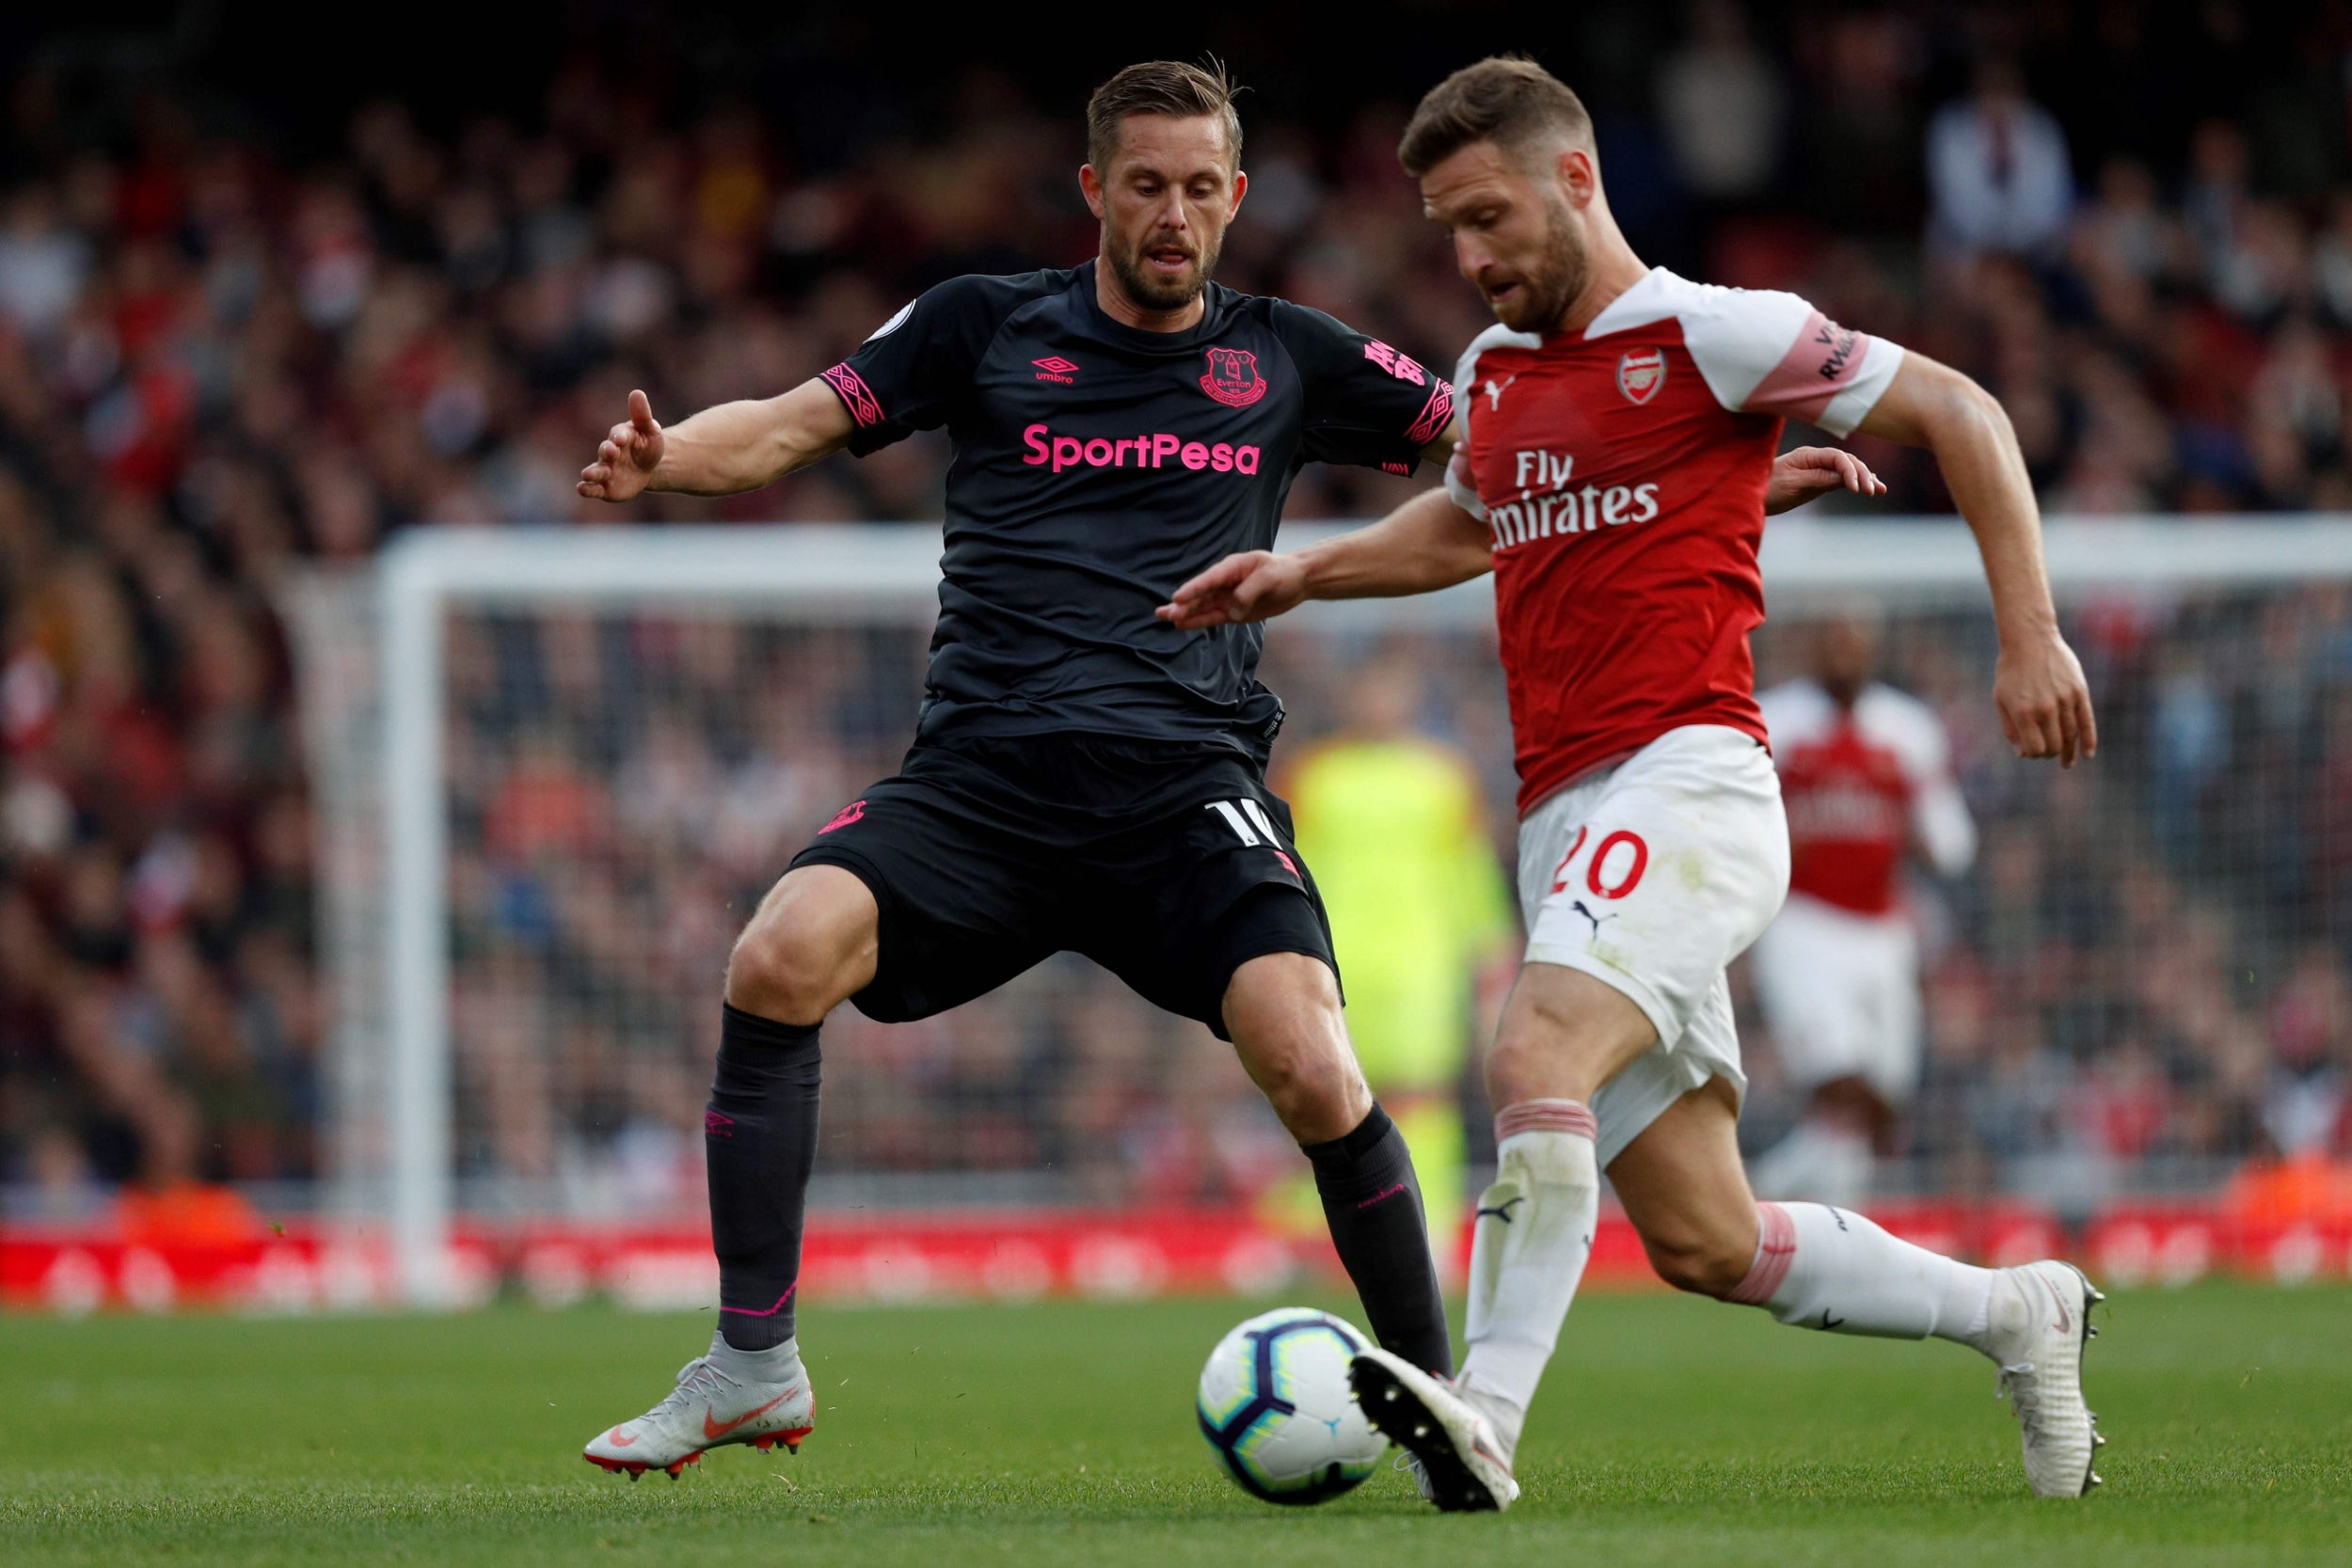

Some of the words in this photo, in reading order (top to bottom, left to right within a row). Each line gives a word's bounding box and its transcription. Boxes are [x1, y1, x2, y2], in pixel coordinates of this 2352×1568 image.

[1036, 372, 1073, 384] umbro
[1216, 378, 1251, 388] Everton
[1023, 423, 1261, 475] SportPesa
[1516, 449, 1574, 491] Fly
[1489, 483, 1660, 552] mirates
